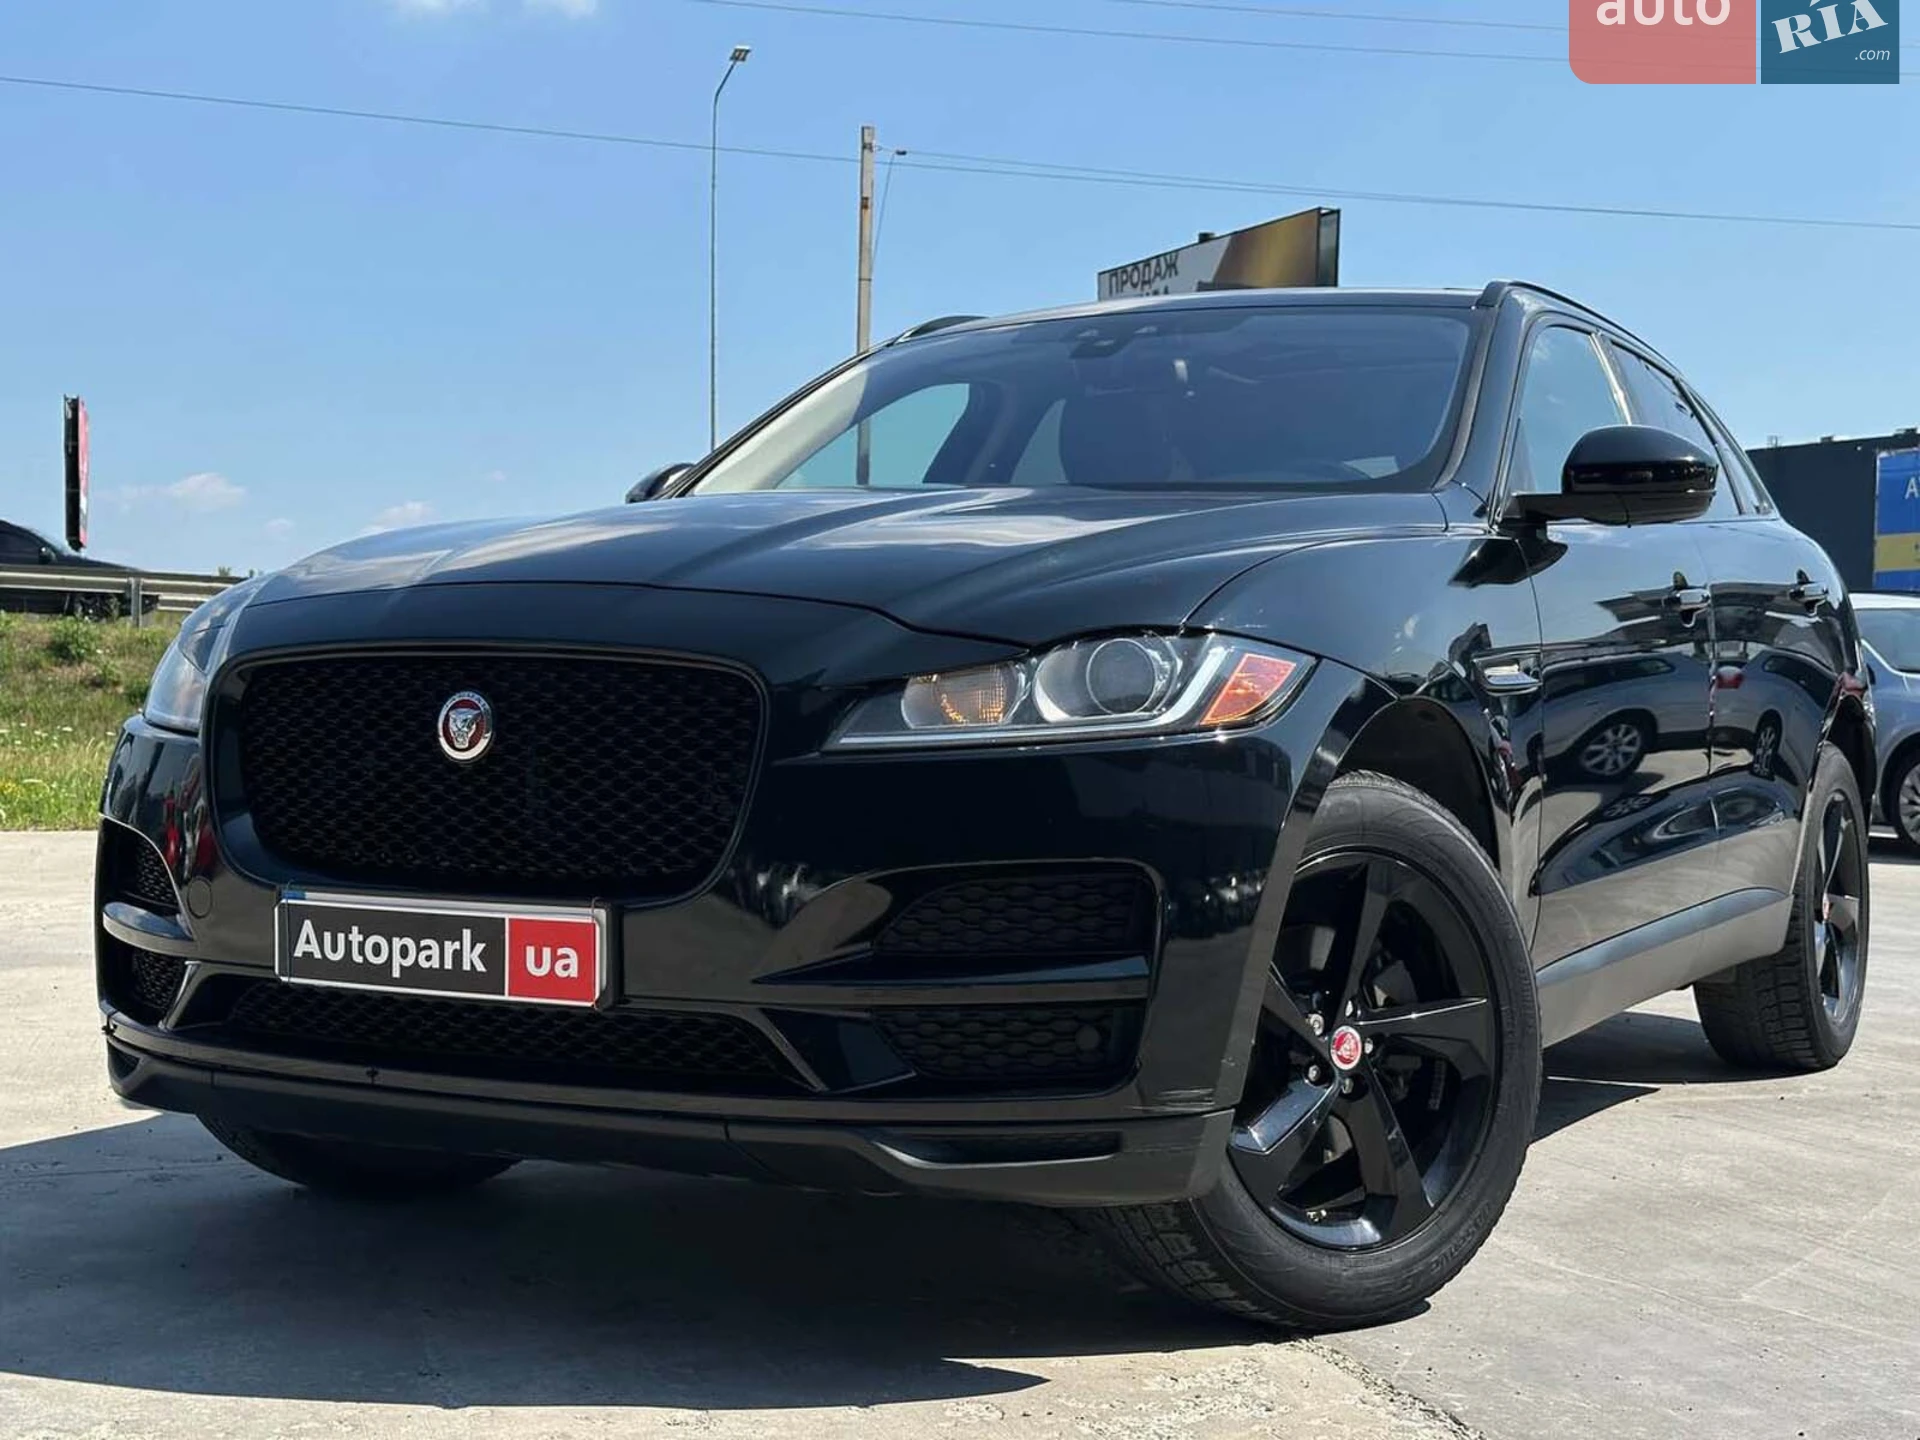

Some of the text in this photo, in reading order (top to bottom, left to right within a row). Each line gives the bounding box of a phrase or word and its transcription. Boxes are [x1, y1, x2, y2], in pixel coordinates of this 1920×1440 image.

[1109, 254, 1179, 297] ПРОДАЖ
[293, 919, 579, 978] Autopark ua
